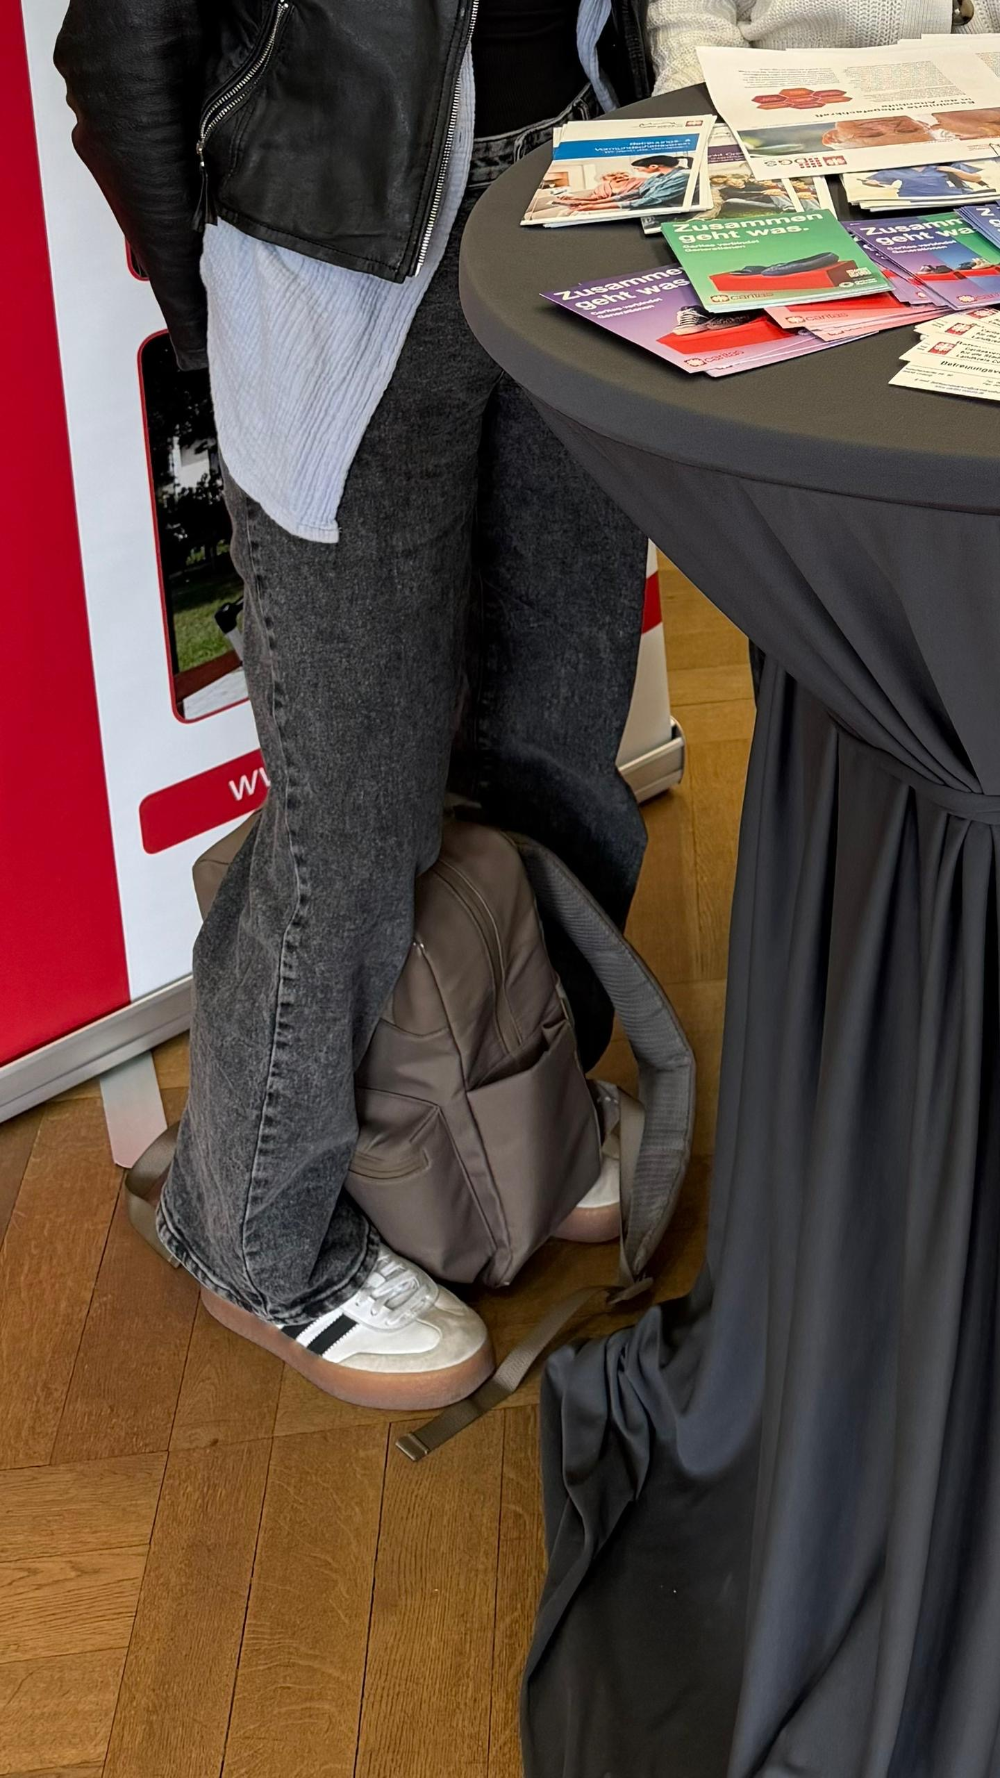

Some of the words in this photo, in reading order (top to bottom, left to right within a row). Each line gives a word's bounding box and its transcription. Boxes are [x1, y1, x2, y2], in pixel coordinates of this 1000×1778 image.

[672, 212, 824, 233] Zusammen
[678, 227, 742, 244] geht
[745, 225, 810, 238] was.
[875, 231, 934, 246] geht
[936, 226, 974, 238] wa
[553, 267, 684, 301] Zusamme
[575, 290, 638, 311] geht
